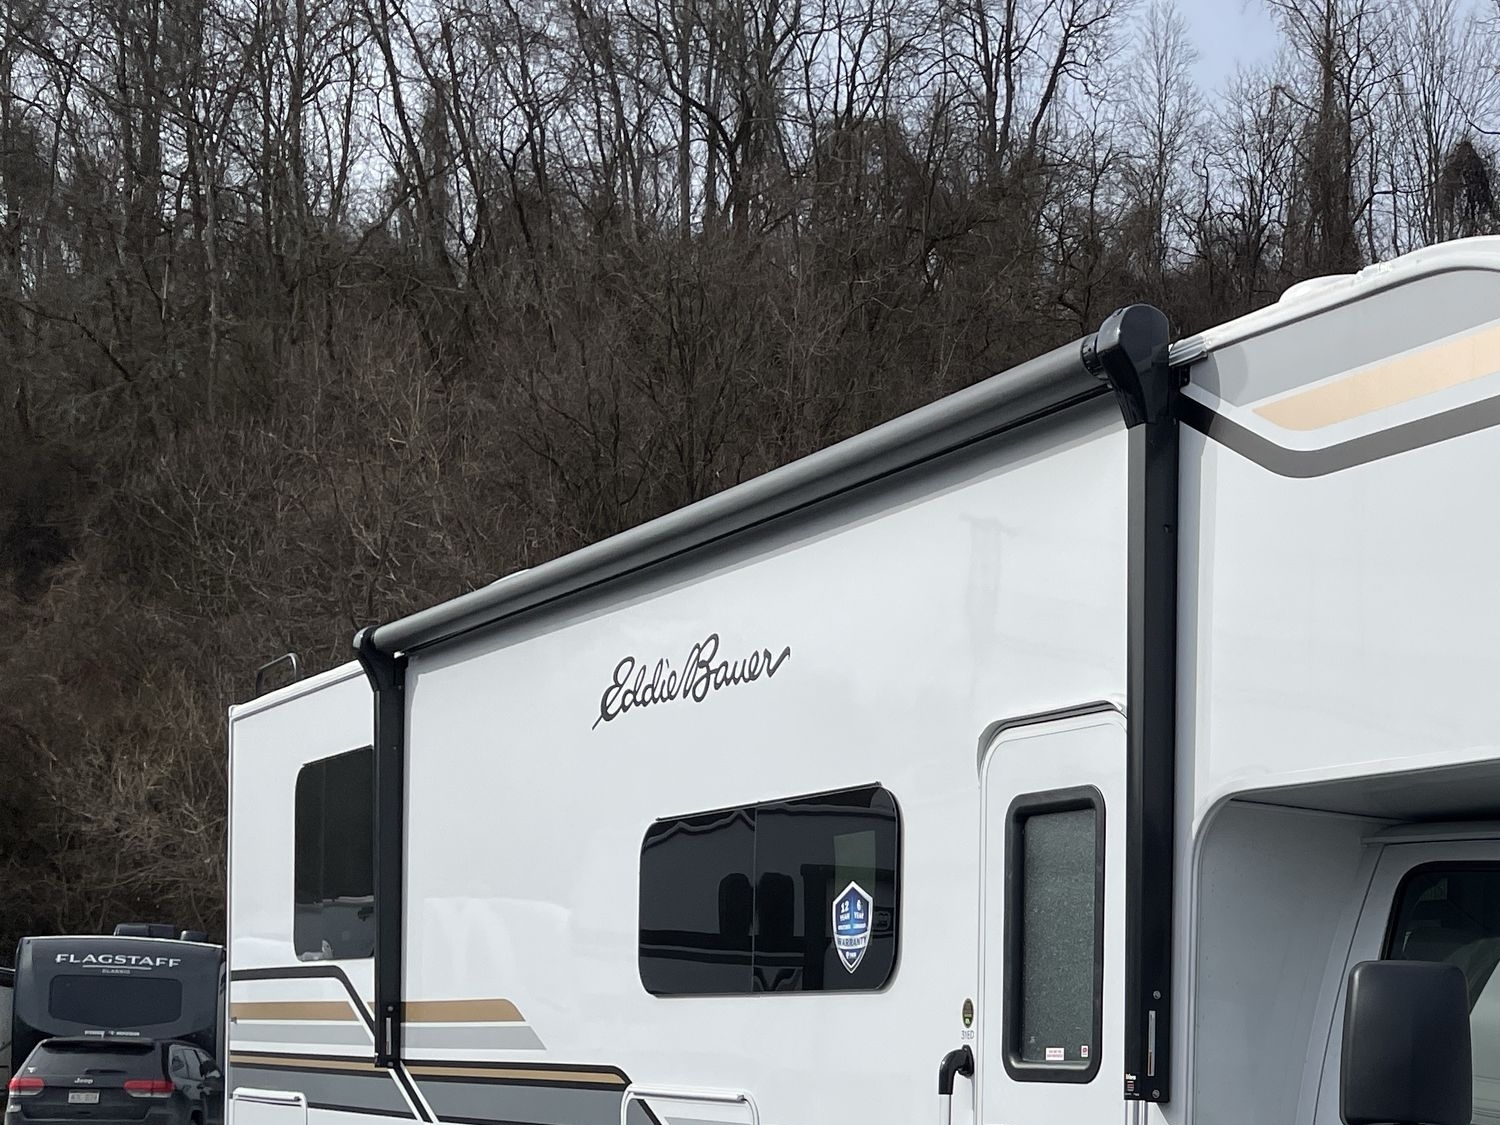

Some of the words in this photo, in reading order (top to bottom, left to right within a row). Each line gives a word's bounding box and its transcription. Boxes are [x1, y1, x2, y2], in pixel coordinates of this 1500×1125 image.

[592, 656, 680, 731] Eddie
[681, 633, 791, 702] Bauer
[840, 900, 850, 914] 12
[837, 935, 867, 948] WARRANTY
[54, 953, 182, 968] FLAGSTAFF
[74, 1077, 94, 1085] Jeep
